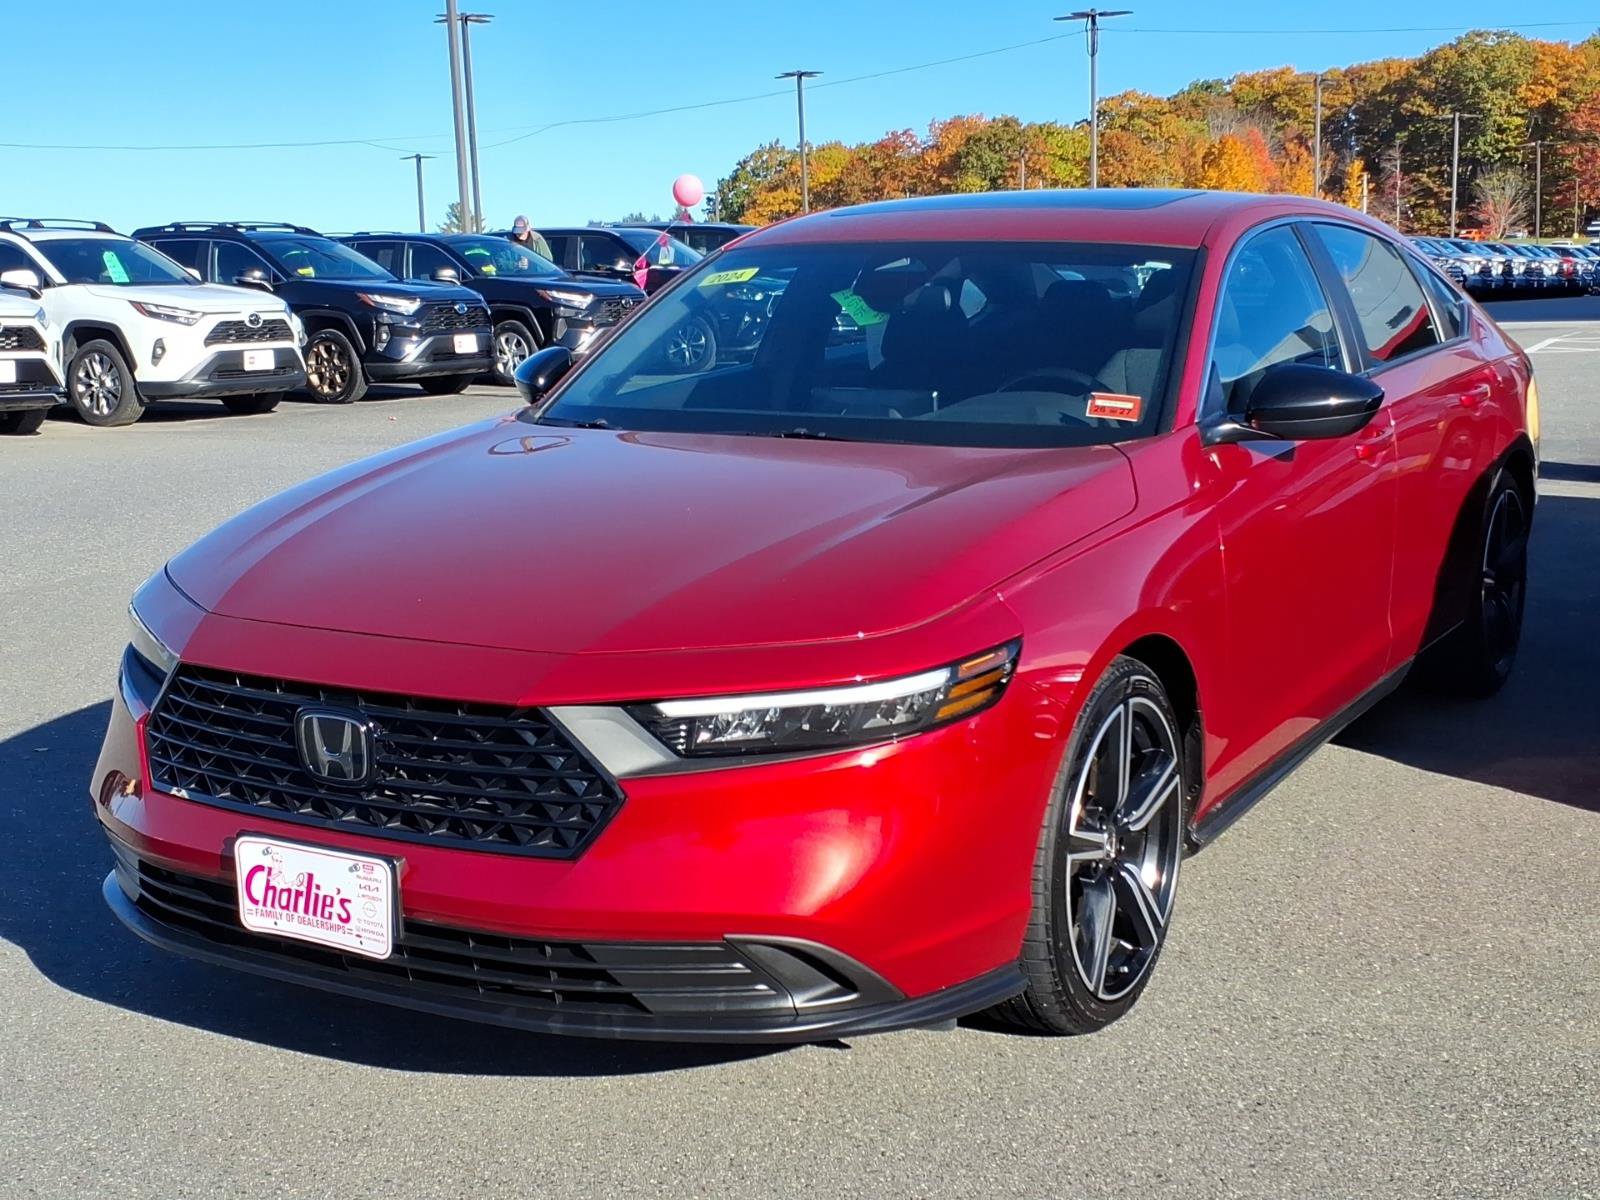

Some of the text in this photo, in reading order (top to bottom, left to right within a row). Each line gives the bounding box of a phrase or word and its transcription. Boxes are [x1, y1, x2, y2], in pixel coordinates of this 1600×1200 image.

[708, 271, 746, 284] 2024
[245, 864, 352, 924] Charlie's
[255, 908, 346, 935] FAMILY OF DEALERSHIPS
[363, 919, 384, 929] TOYOTA
[361, 928, 385, 938] HONDA
